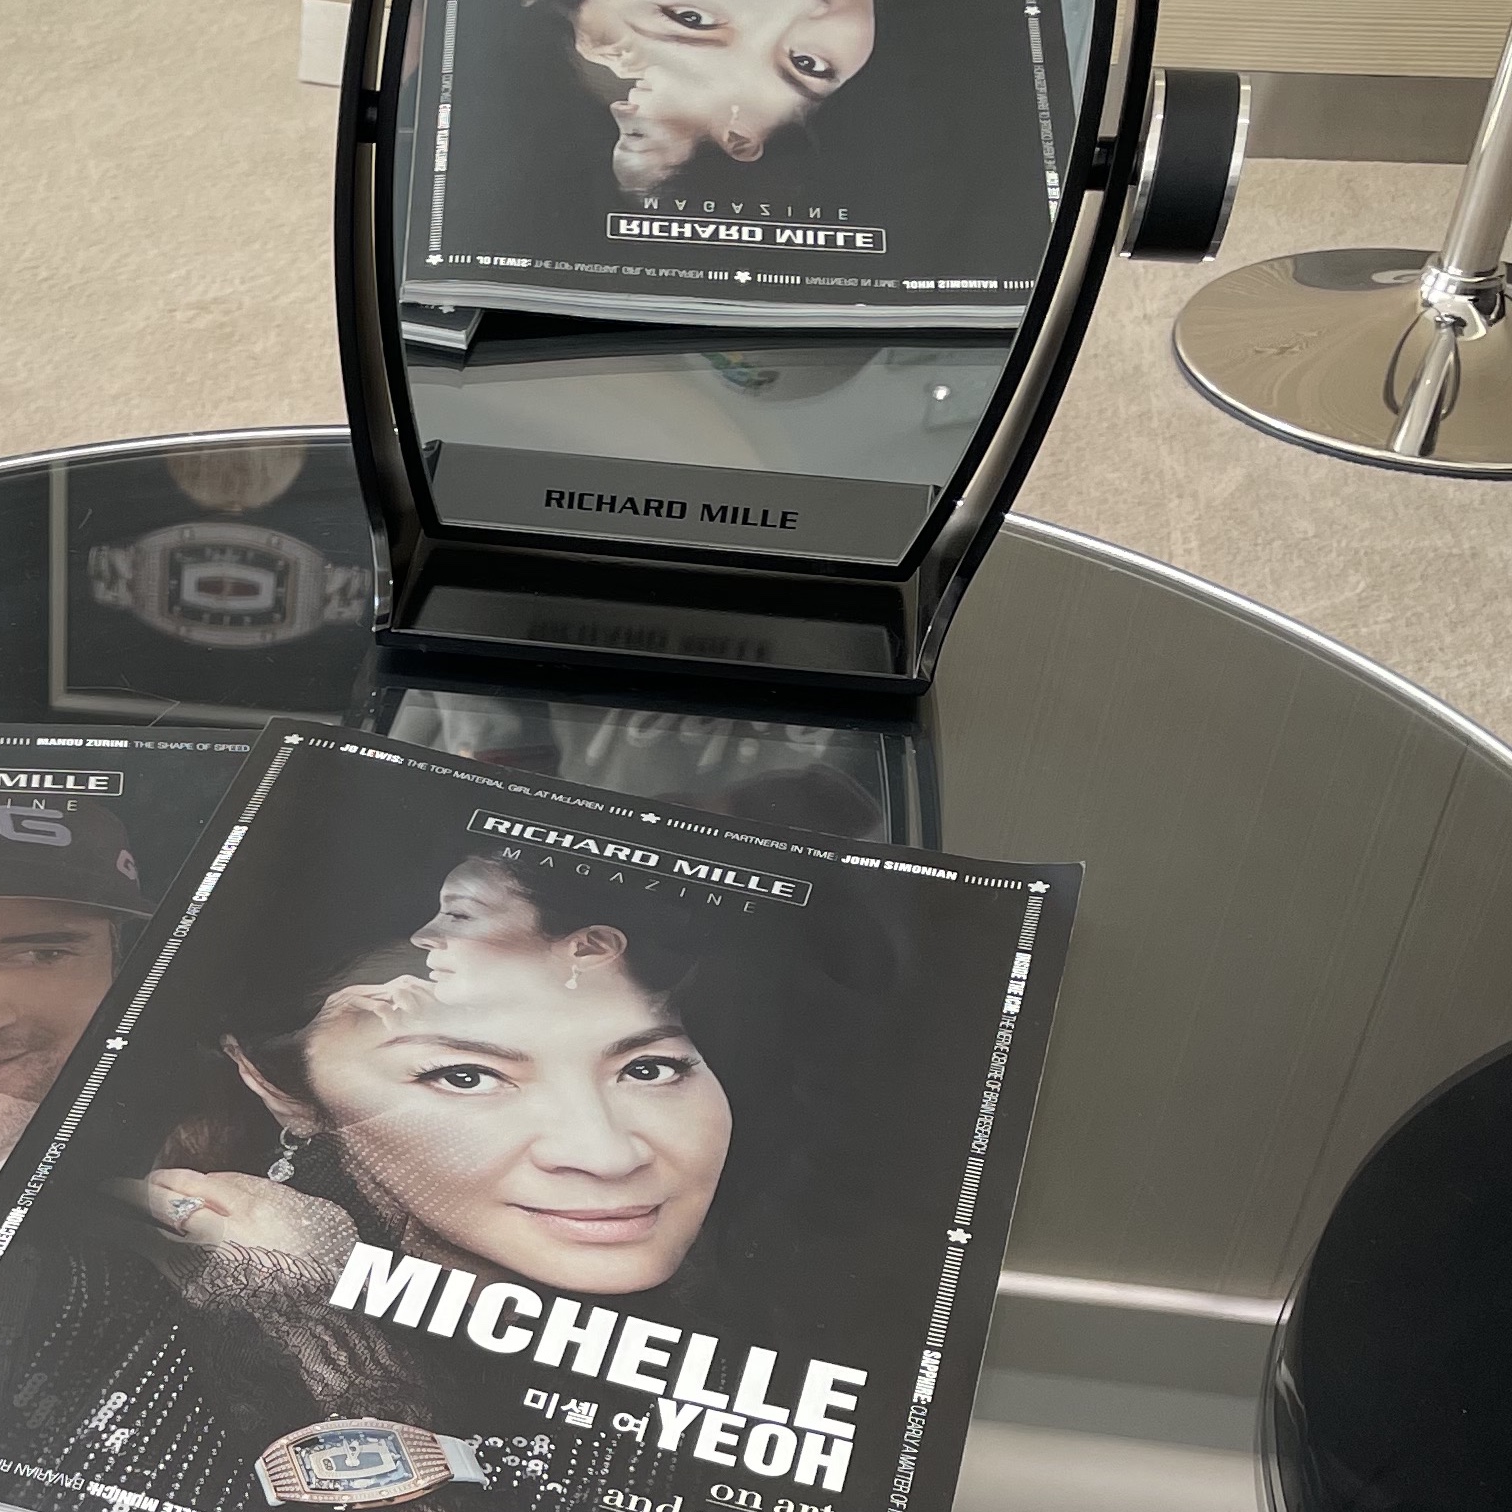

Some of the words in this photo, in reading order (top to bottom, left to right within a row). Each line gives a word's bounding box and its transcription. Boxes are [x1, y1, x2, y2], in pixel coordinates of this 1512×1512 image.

[544, 489, 688, 520] RICHARD
[699, 503, 799, 530] MILLE
[36, 737, 83, 746] MANOU
[157, 742, 193, 750] SHAPE
[214, 743, 250, 752] SPEED
[407, 759, 427, 770] THE
[430, 764, 452, 776] TOP
[453, 770, 505, 789] MATERIAL
[507, 783, 532, 795] GIRL
[533, 788, 549, 799] AT
[483, 816, 661, 867] RICHARD
[673, 858, 797, 898] MILLE
[723, 830, 787, 851] PARTNERS
[790, 844, 803, 853] IN
[840, 853, 881, 868] JOHN
[883, 861, 957, 881] SIMONIAN
[502, 846, 757, 914] MAGAZINE
[172, 915, 197, 938] COMIC
[192, 872, 222, 902] COMING
[1011, 951, 1032, 980] INSIDE
[1006, 980, 1026, 996] THE
[999, 1015, 1017, 1029] THE
[994, 1029, 1013, 1052] NERVE
[987, 1052, 1009, 1080] CENTRE
[984, 1079, 1001, 1092] OF
[979, 1091, 1000, 1115] BRAIN
[970, 1113, 995, 1155] RESEARCH
[43, 1142, 67, 1164] POPS
[30, 1163, 54, 1182] THAT
[17, 1181, 44, 1207] STYLE
[328, 1240, 868, 1442] MICHELLE
[612, 1412, 650, 1443] 여
[903, 1405, 928, 1447] CLEARLY
[653, 1396, 855, 1493] YEOH
[12, 1461, 85, 1491] BAVARIAN
[892, 1453, 917, 1493] MATTER
[710, 1483, 763, 1511] on
[888, 1492, 909, 1509] OF
